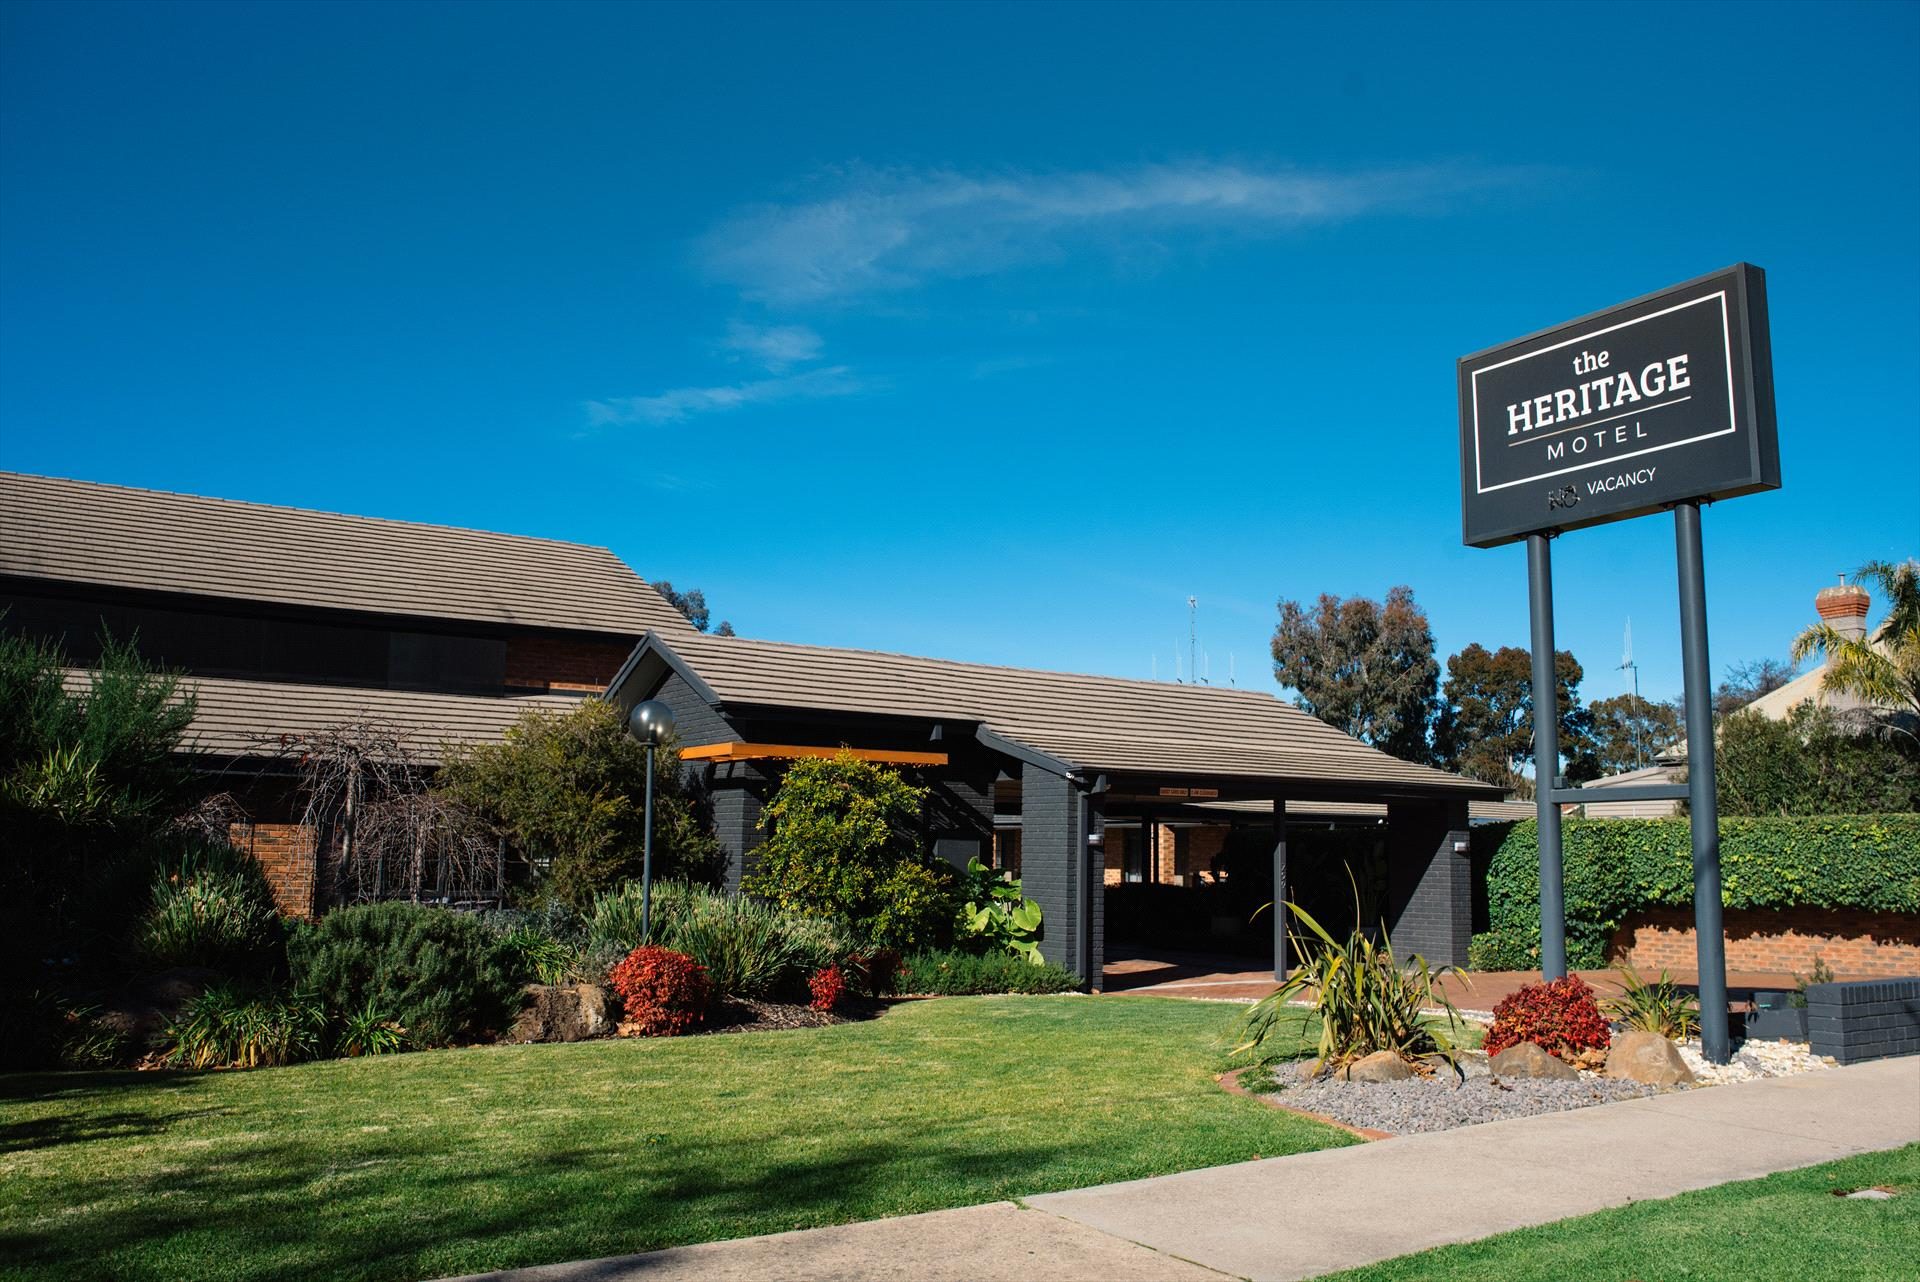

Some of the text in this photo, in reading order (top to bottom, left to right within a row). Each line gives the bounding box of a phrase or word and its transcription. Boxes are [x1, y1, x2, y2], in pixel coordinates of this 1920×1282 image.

[1573, 351, 1609, 375] the
[1507, 354, 1691, 435] HERITAGE
[1548, 421, 1647, 460] MOTEL
[1587, 467, 1656, 495] VACANCY
